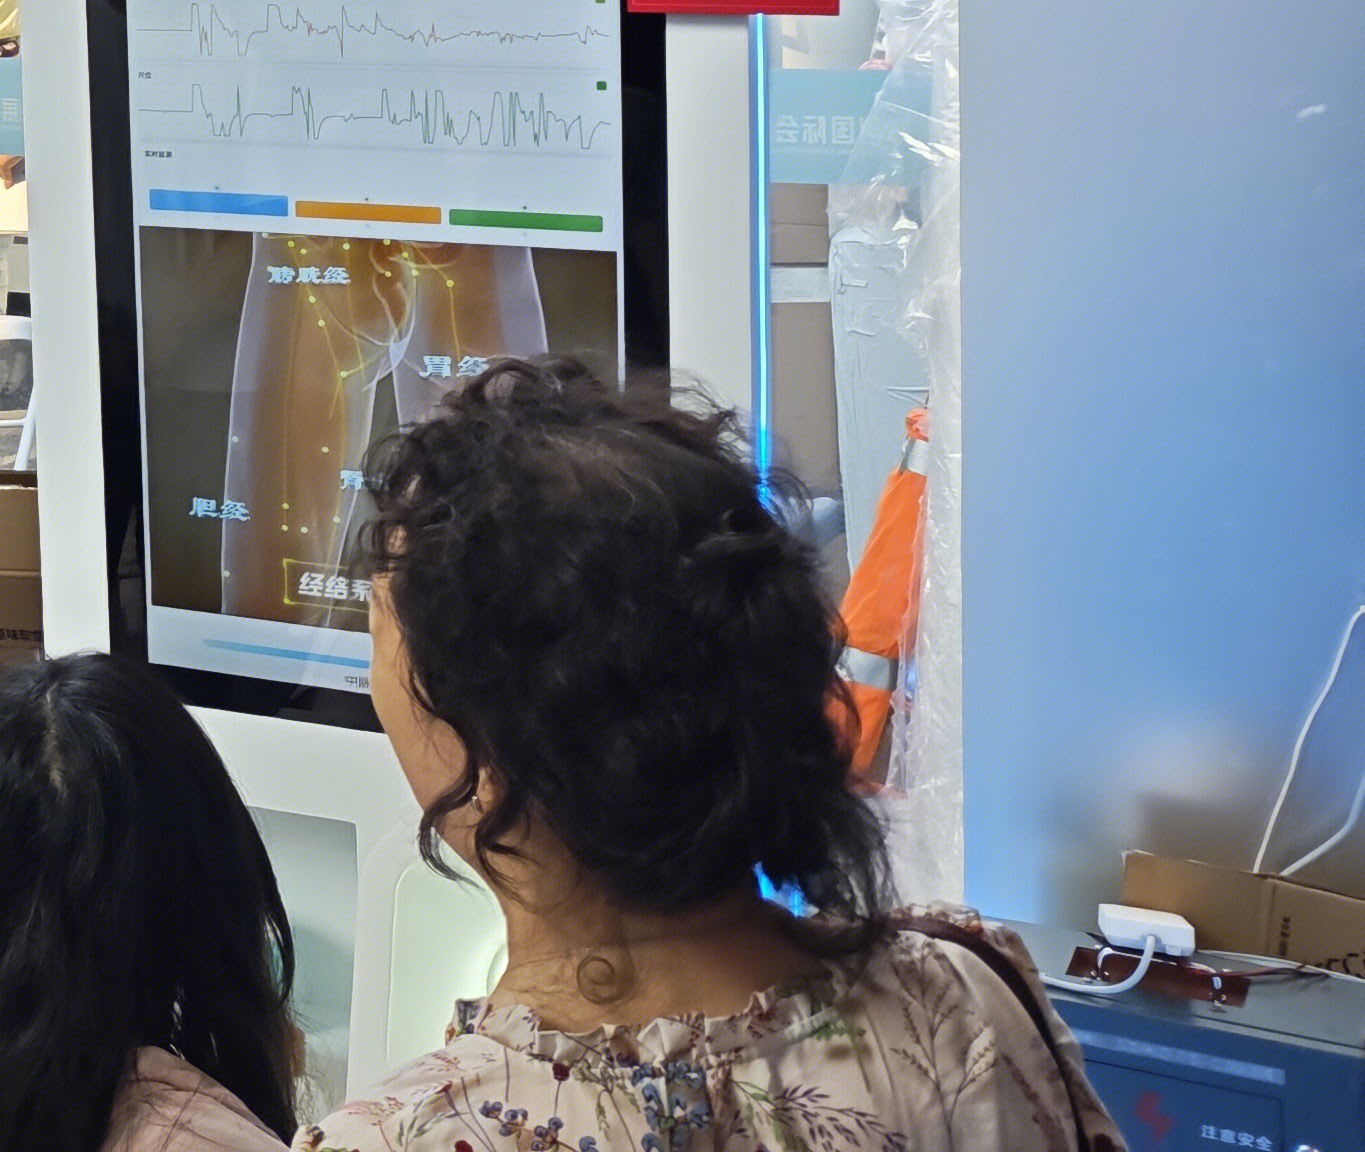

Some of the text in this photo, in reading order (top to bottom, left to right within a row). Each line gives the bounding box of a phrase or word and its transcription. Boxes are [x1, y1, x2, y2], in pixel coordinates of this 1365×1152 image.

[138, 71, 152, 79] 尺位
[268, 265, 352, 286] 膀胱经
[419, 354, 490, 378] 胃经
[188, 496, 252, 523] 胆经
[1201, 1124, 1274, 1152] 注意安全
